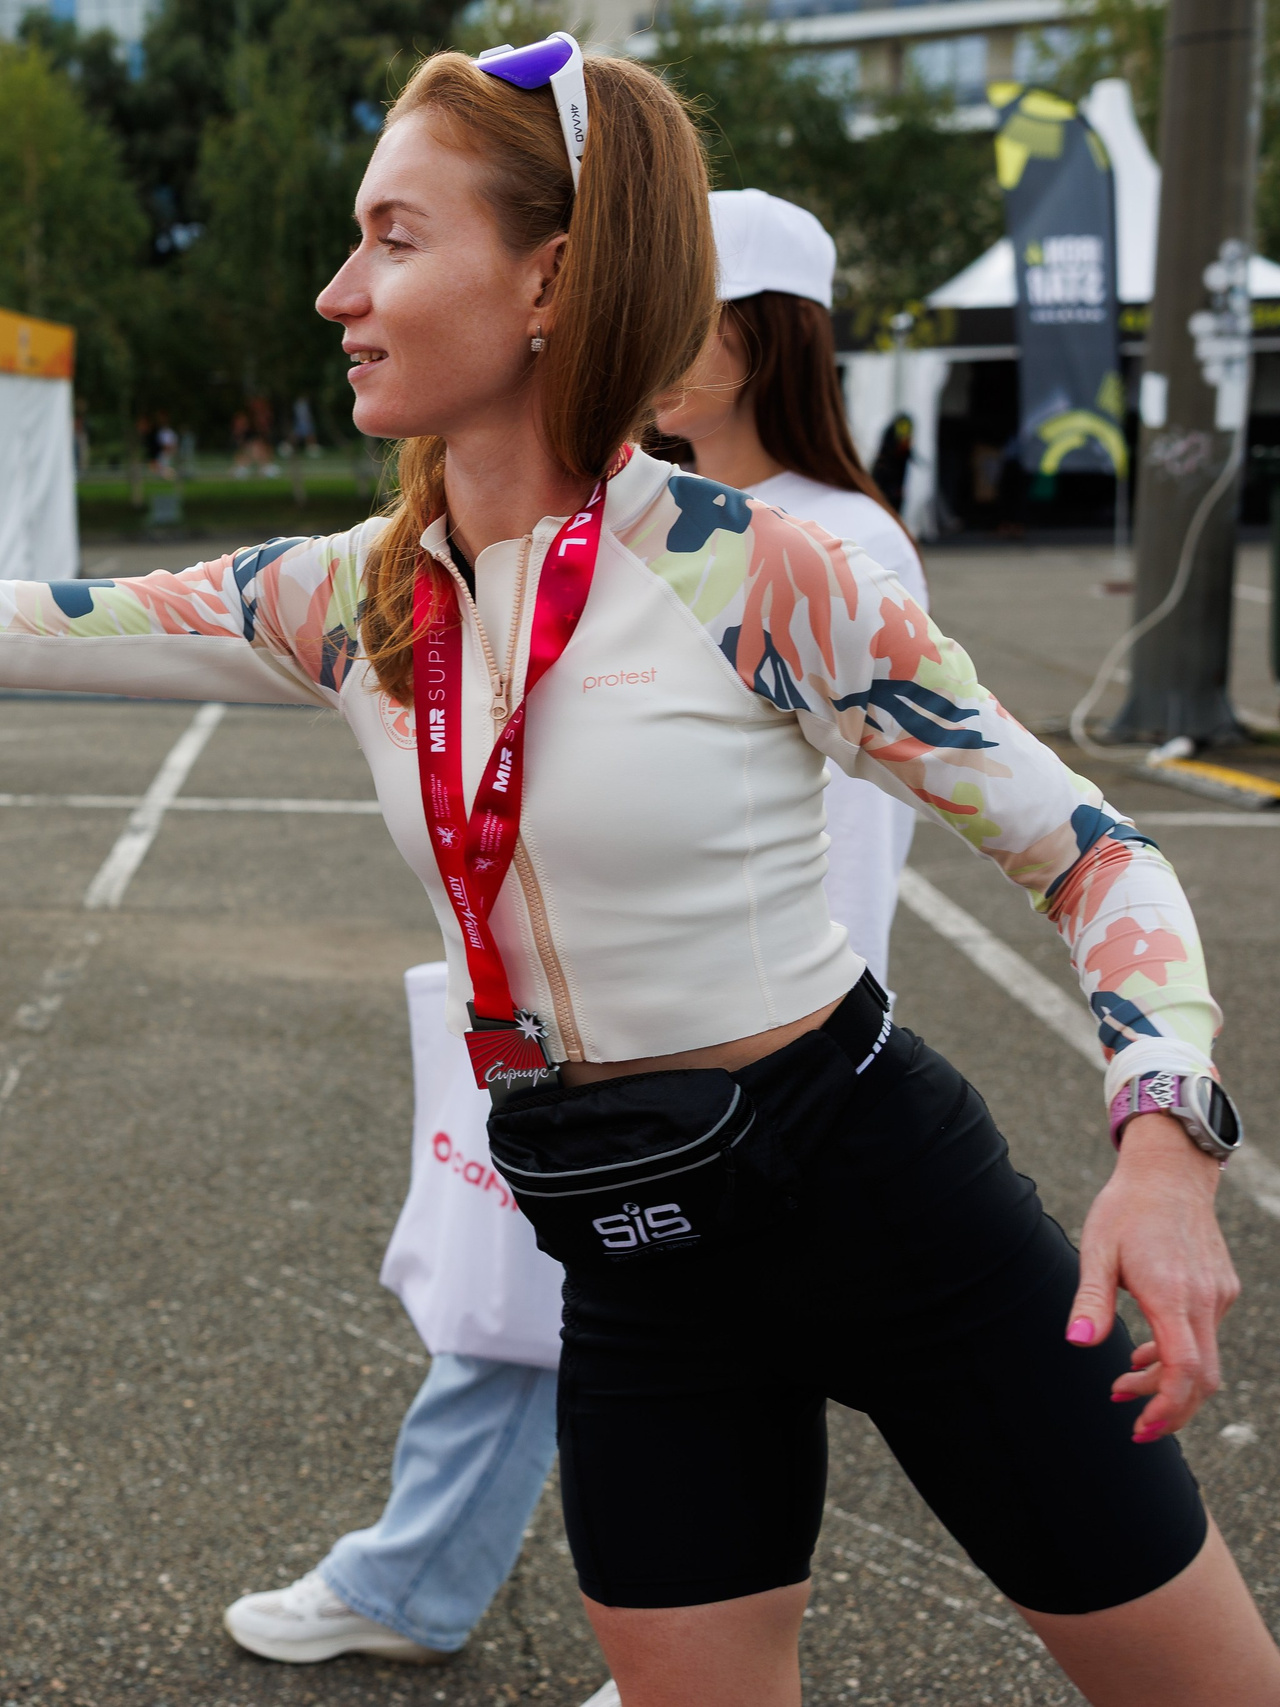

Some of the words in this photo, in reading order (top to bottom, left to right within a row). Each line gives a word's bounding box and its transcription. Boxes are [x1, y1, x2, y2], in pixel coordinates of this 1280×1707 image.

[582, 666, 658, 694] protest
[429, 708, 447, 753] MIR
[492, 747, 513, 793] MIR
[448, 875, 467, 907] LADY
[463, 919, 482, 949] IRON
